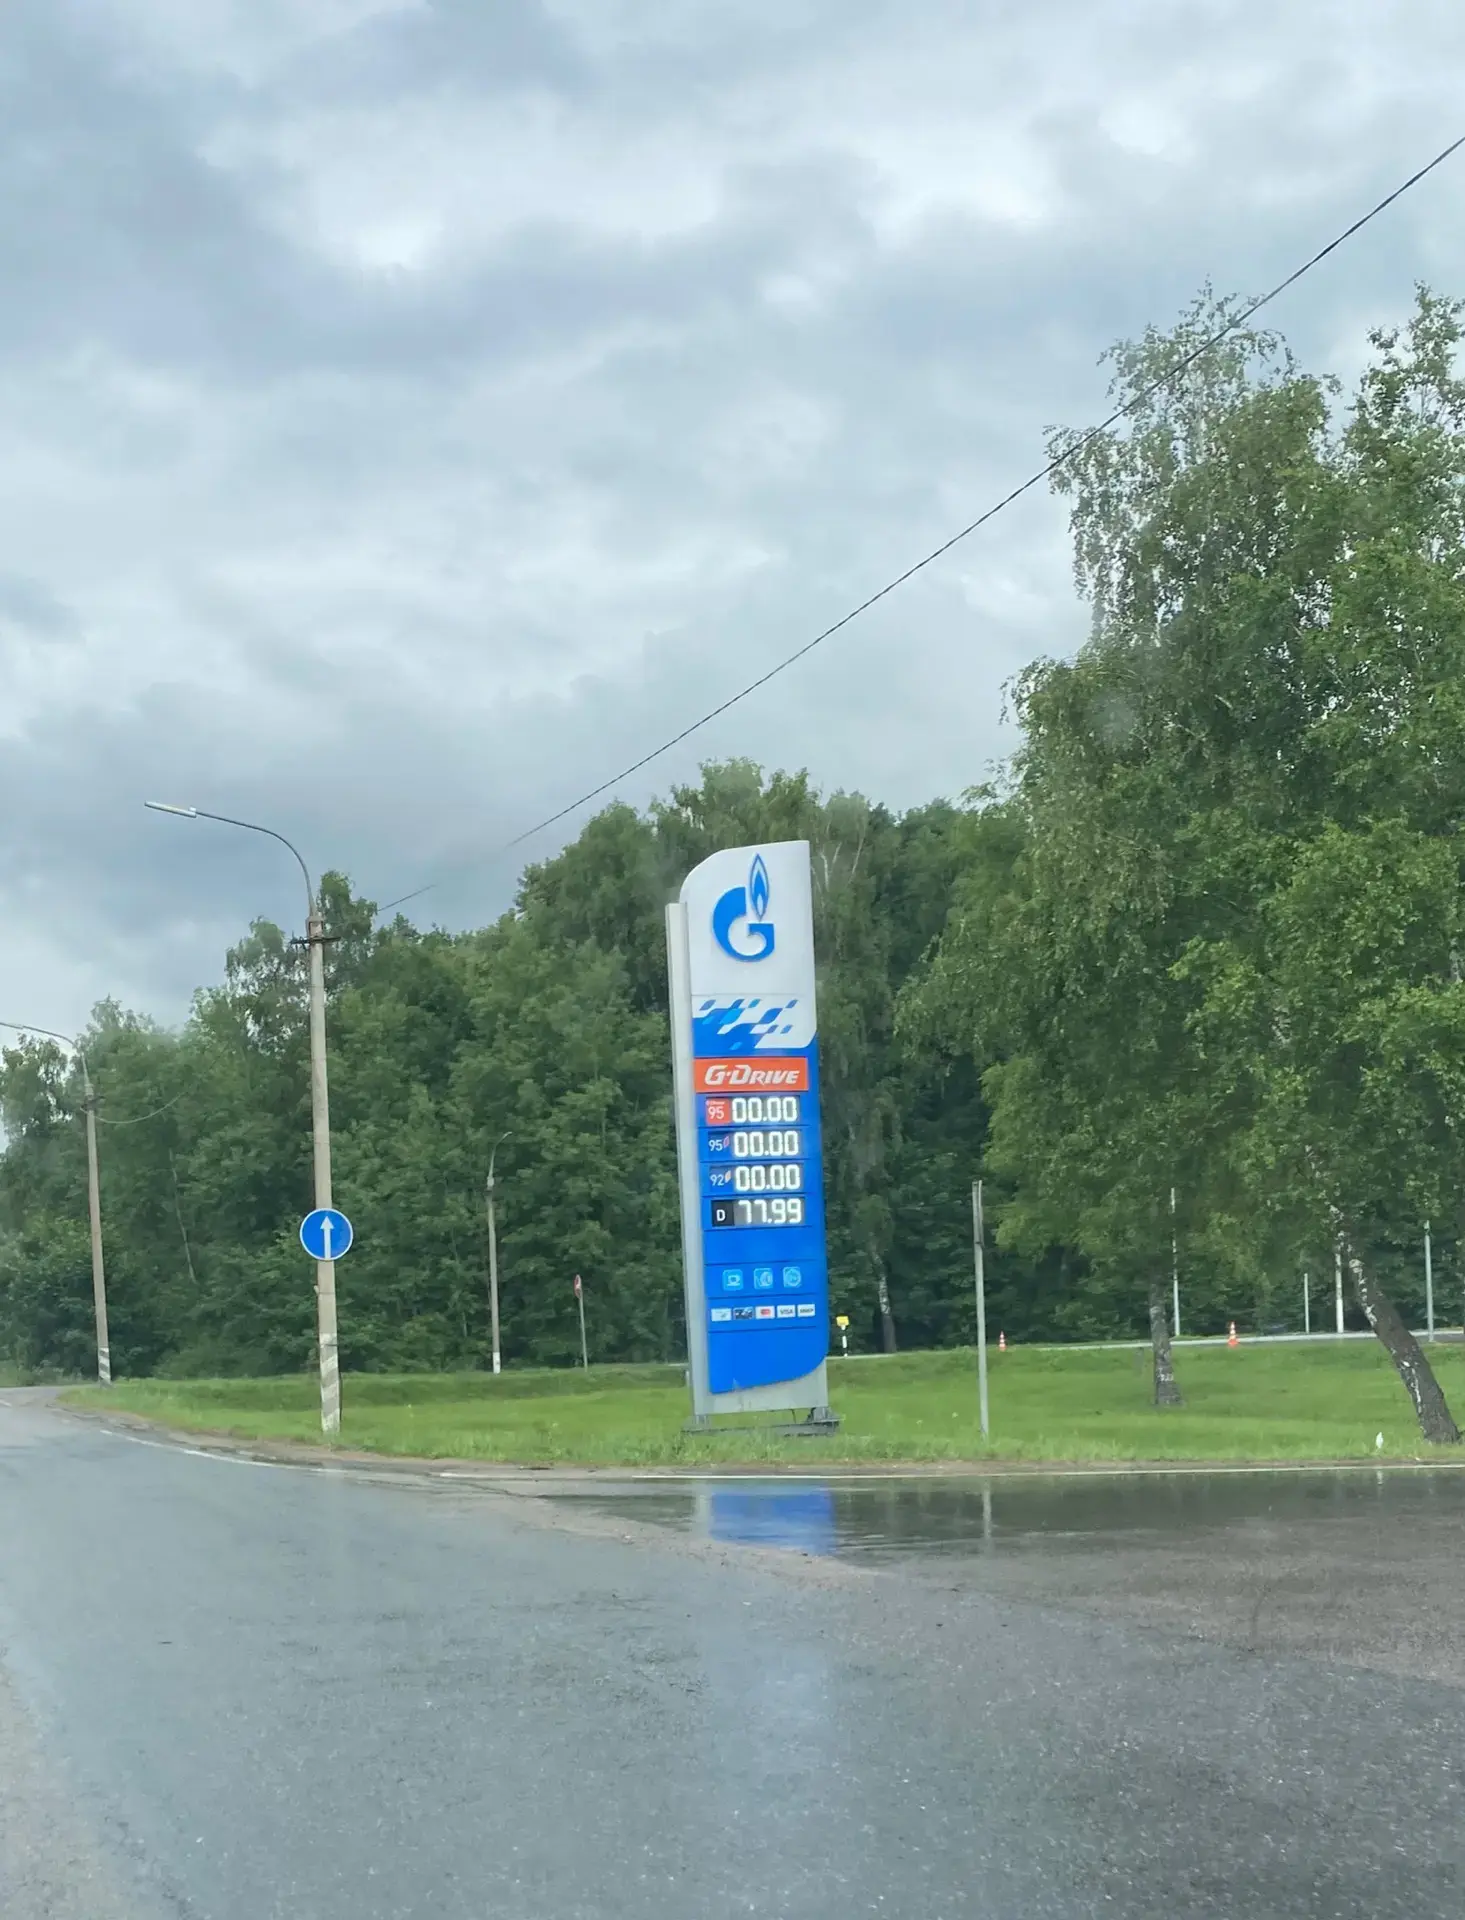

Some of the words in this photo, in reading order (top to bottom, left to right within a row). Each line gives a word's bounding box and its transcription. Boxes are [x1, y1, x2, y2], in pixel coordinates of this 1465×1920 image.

[708, 1105, 725, 1120] 95
[731, 1096, 798, 1123] 00.00
[708, 1139, 723, 1152] 95
[733, 1130, 799, 1157] 00.00
[710, 1174, 725, 1187] 92
[735, 1164, 801, 1191] 00.00
[716, 1209, 726, 1221] D
[738, 1198, 802, 1224] 77.99
